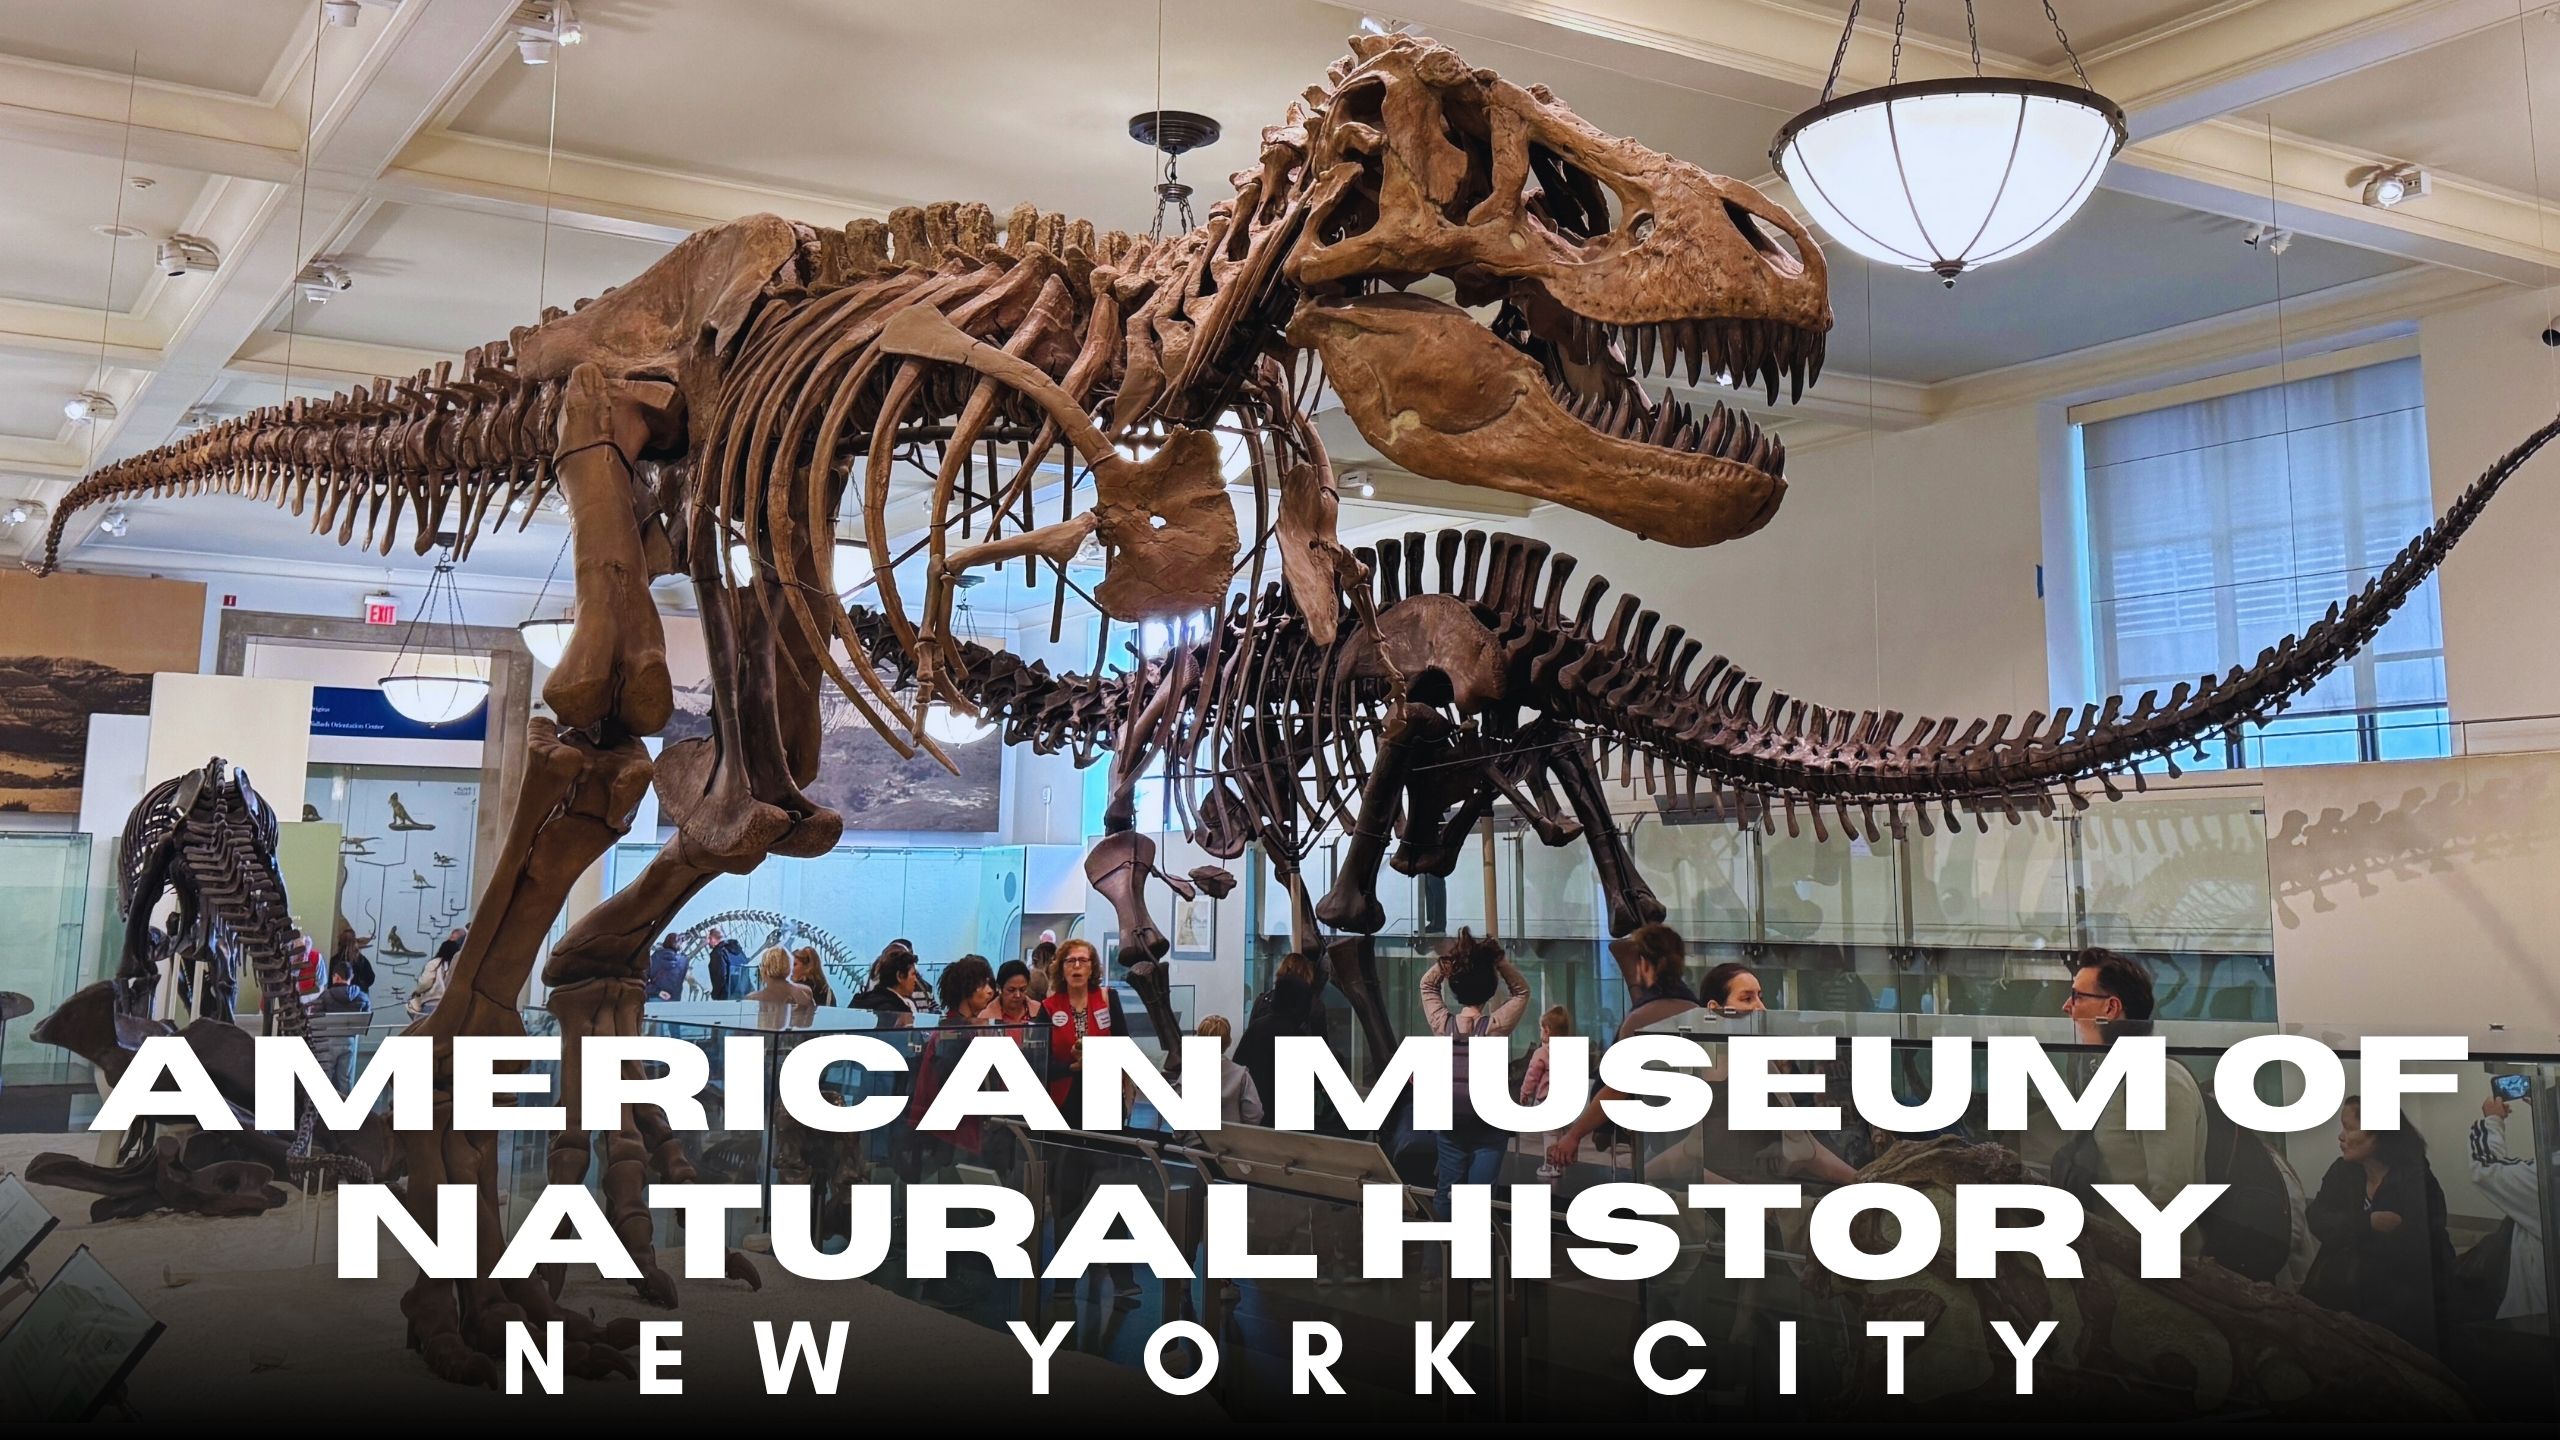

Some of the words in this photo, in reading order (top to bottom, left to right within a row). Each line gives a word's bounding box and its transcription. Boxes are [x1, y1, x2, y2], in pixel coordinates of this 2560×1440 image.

[370, 604, 395, 624] EXIT
[330, 720, 364, 730] Orientation
[364, 722, 385, 731] Center
